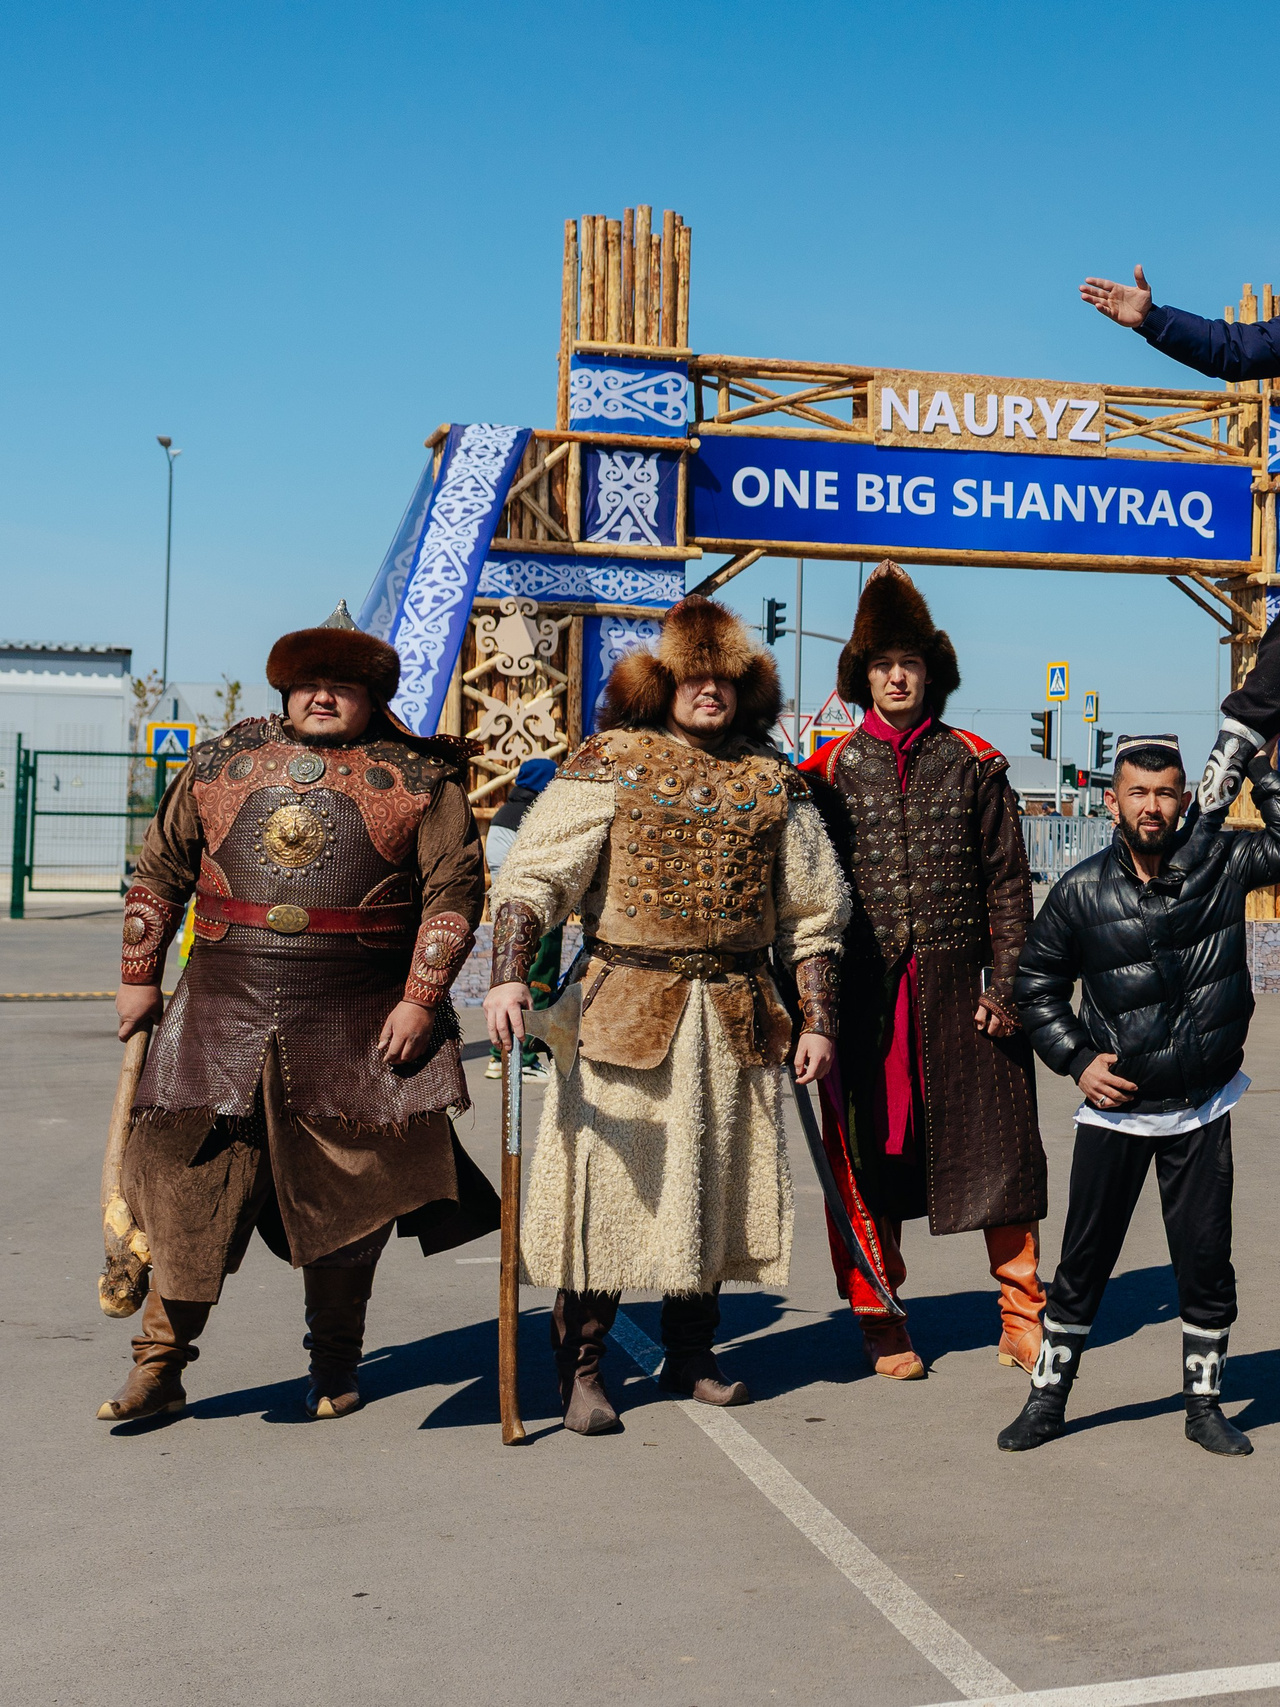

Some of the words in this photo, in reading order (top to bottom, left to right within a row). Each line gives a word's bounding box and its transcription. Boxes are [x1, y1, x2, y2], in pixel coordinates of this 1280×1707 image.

[880, 387, 1101, 442] NAURYZ
[731, 466, 839, 511] ONE
[856, 472, 936, 516] BIG
[952, 477, 1215, 539] SHANYRAQ
